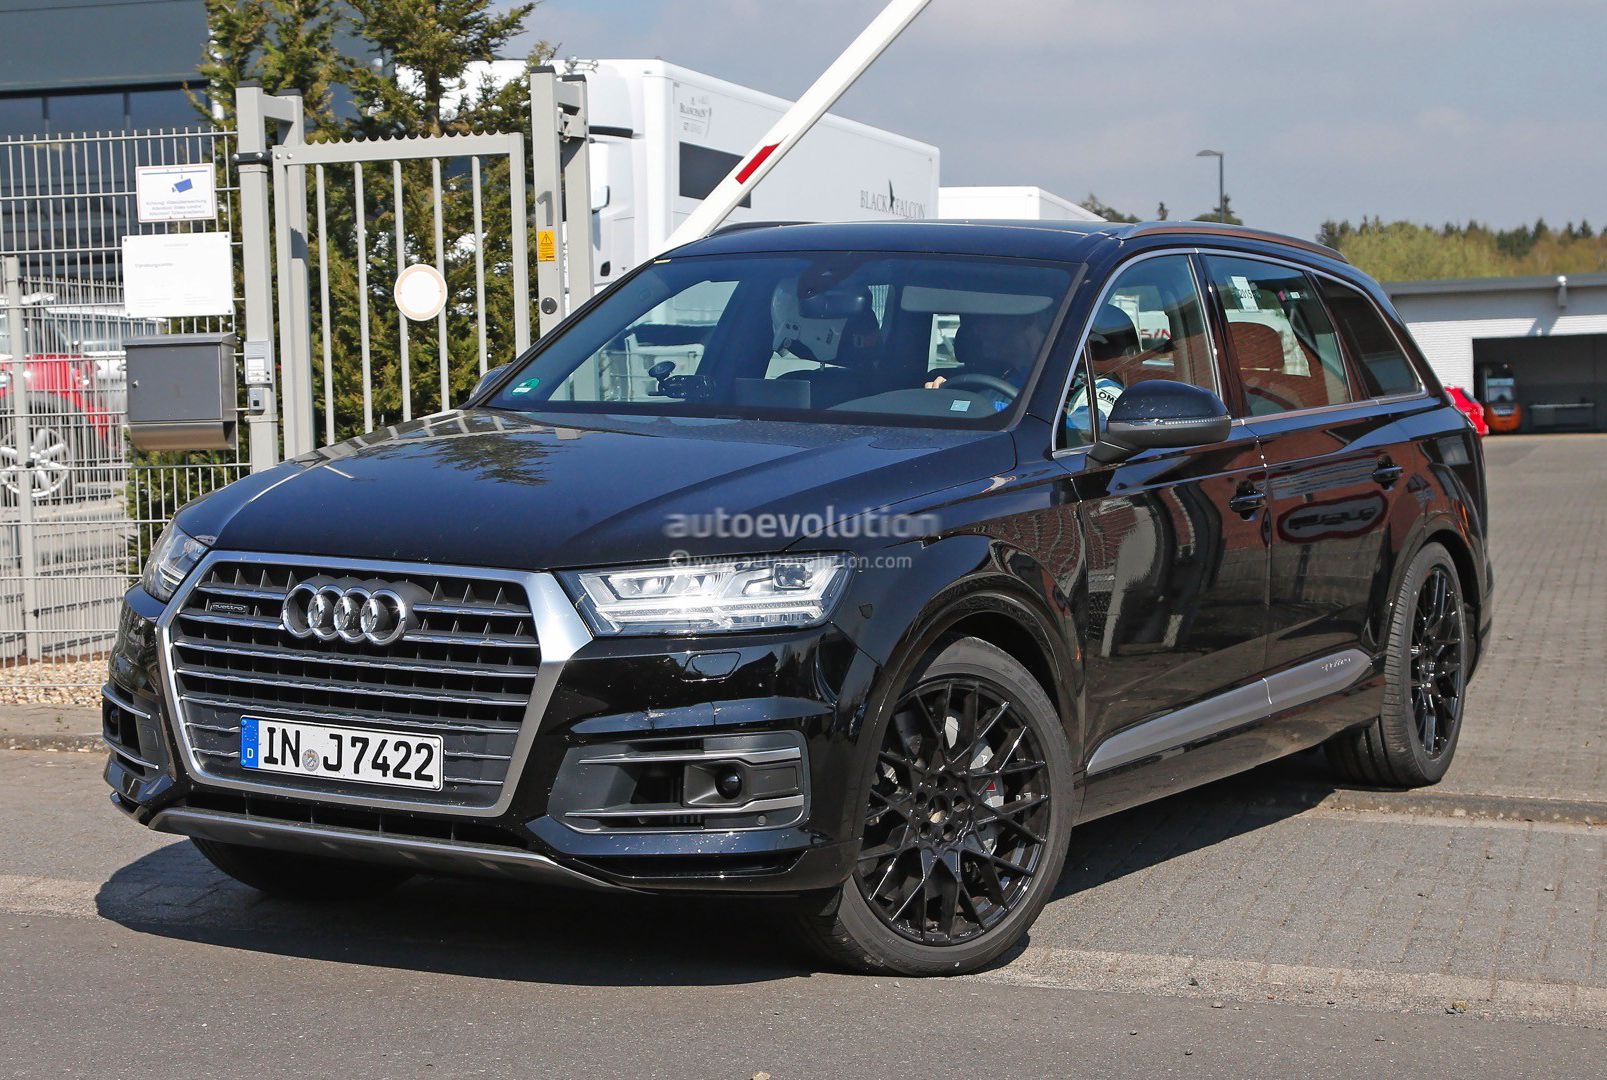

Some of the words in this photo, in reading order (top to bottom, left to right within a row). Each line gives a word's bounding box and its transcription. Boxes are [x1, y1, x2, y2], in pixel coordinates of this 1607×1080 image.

[860, 189, 888, 213] BLACK
[247, 747, 254, 759] D
[264, 726, 300, 768] IN
